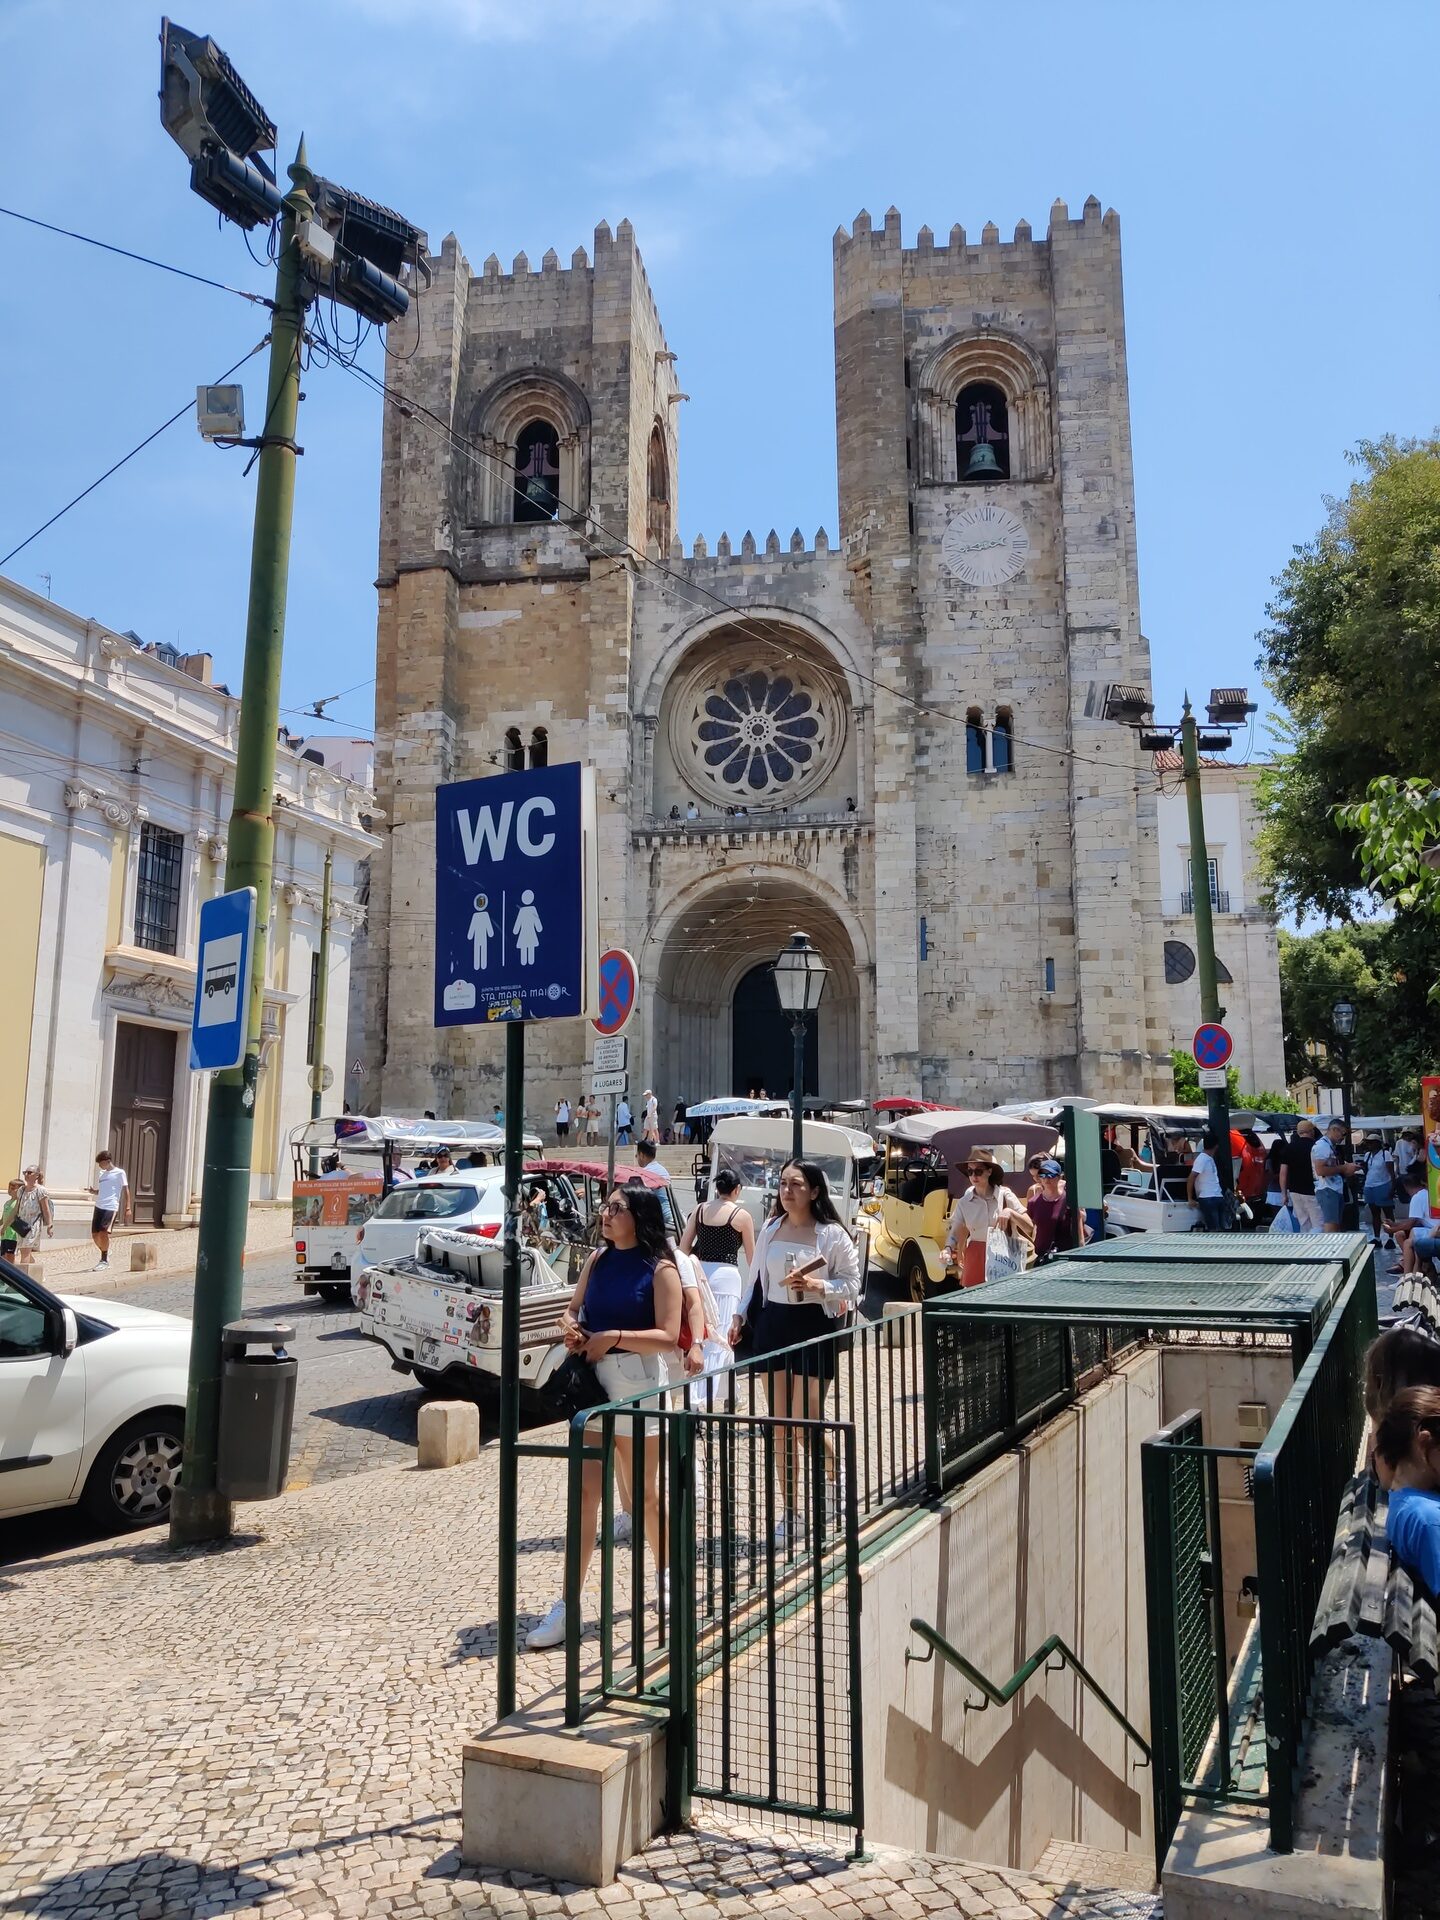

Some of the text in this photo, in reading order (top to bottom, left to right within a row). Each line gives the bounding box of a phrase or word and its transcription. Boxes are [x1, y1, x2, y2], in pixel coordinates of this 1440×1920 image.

[457, 796, 556, 865] WC
[498, 989, 527, 1000] MARIA
[599, 1079, 623, 1088] LUGARES
[427, 1344, 436, 1354] 09
[421, 1352, 430, 1361] NF
